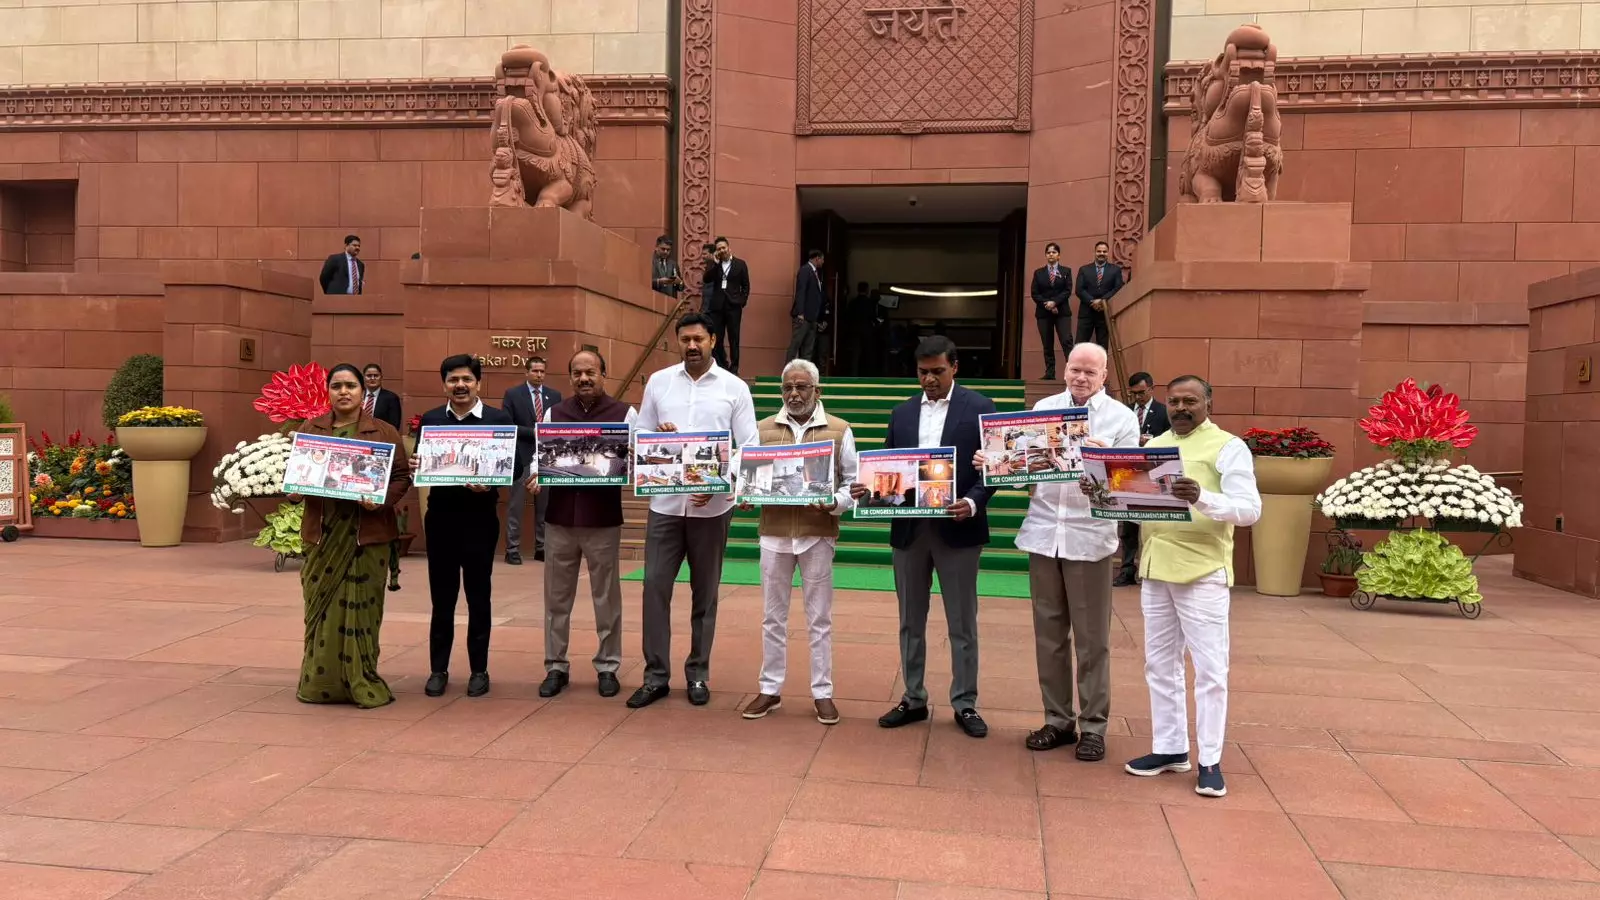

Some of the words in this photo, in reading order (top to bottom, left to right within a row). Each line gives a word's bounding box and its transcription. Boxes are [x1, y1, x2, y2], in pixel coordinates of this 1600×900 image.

[491, 335, 522, 349] मकर
[526, 336, 548, 352] द्वार
[474, 353, 508, 367] akar
